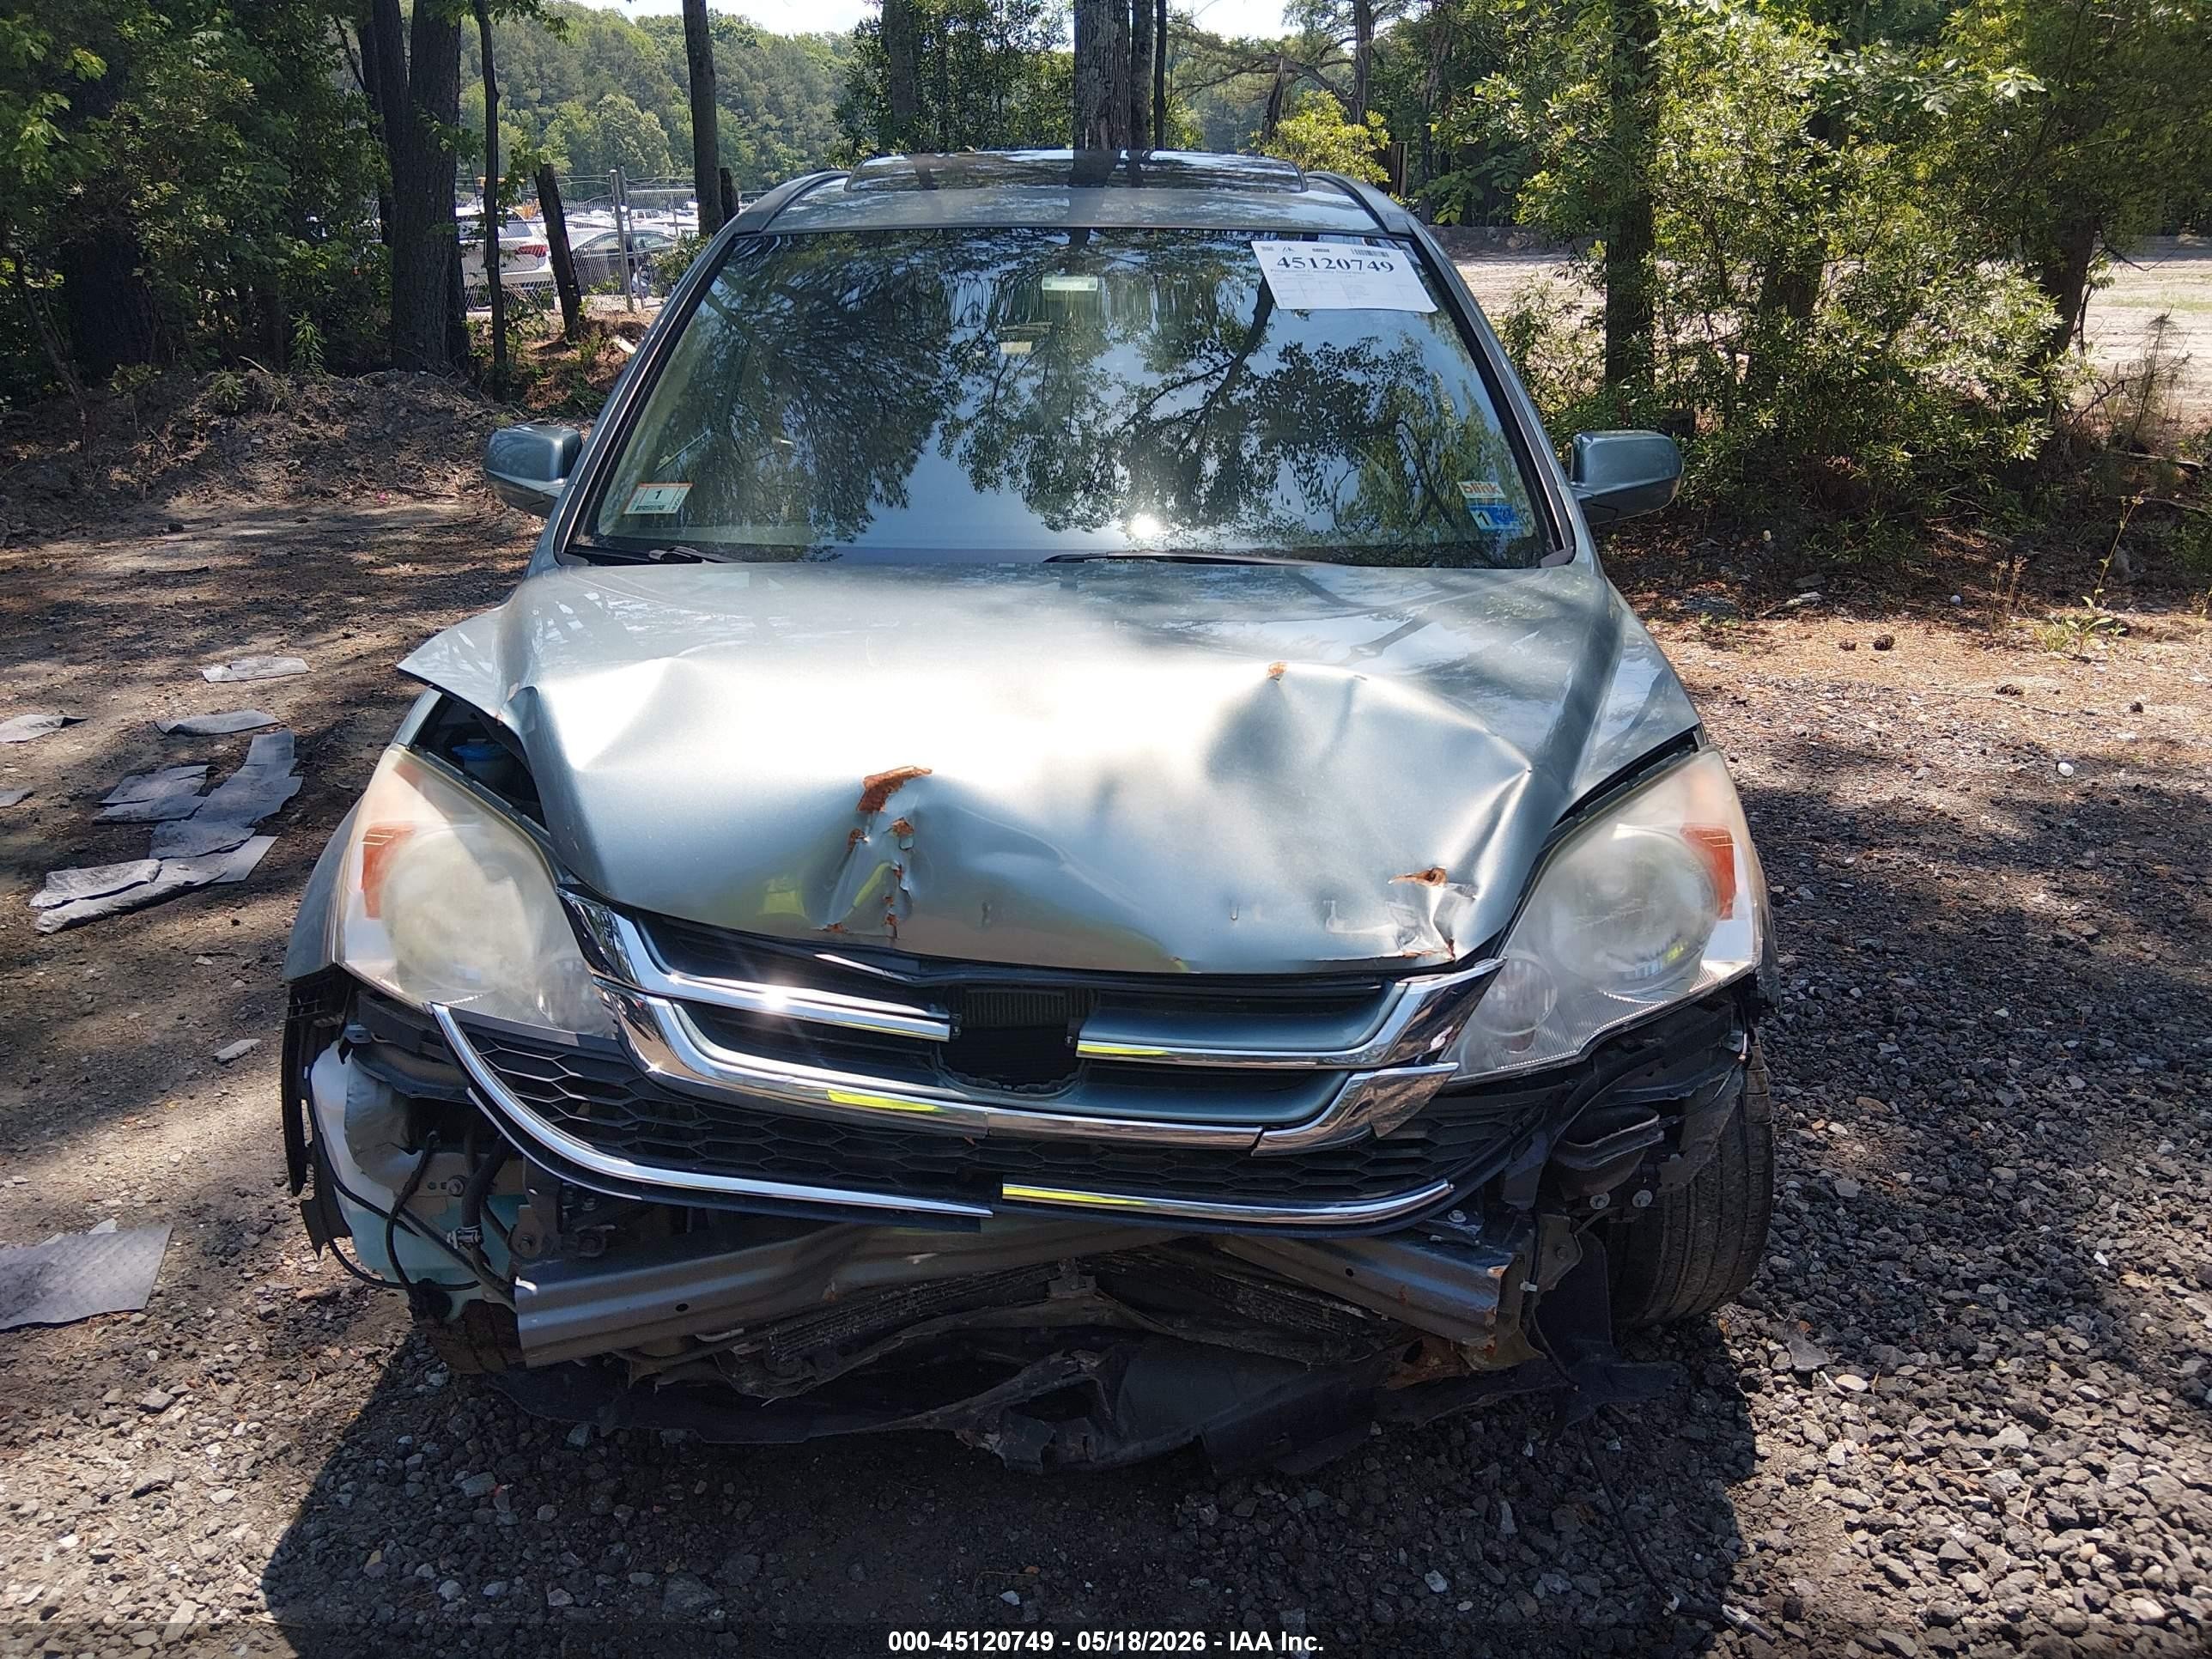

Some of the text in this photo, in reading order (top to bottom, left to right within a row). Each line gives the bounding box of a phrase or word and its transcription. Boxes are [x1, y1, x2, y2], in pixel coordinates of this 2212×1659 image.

[1277, 256, 1395, 273] 45120749
[654, 489, 663, 500] 1
[1462, 483, 1502, 495] blink
[1477, 511, 1490, 526] 1
